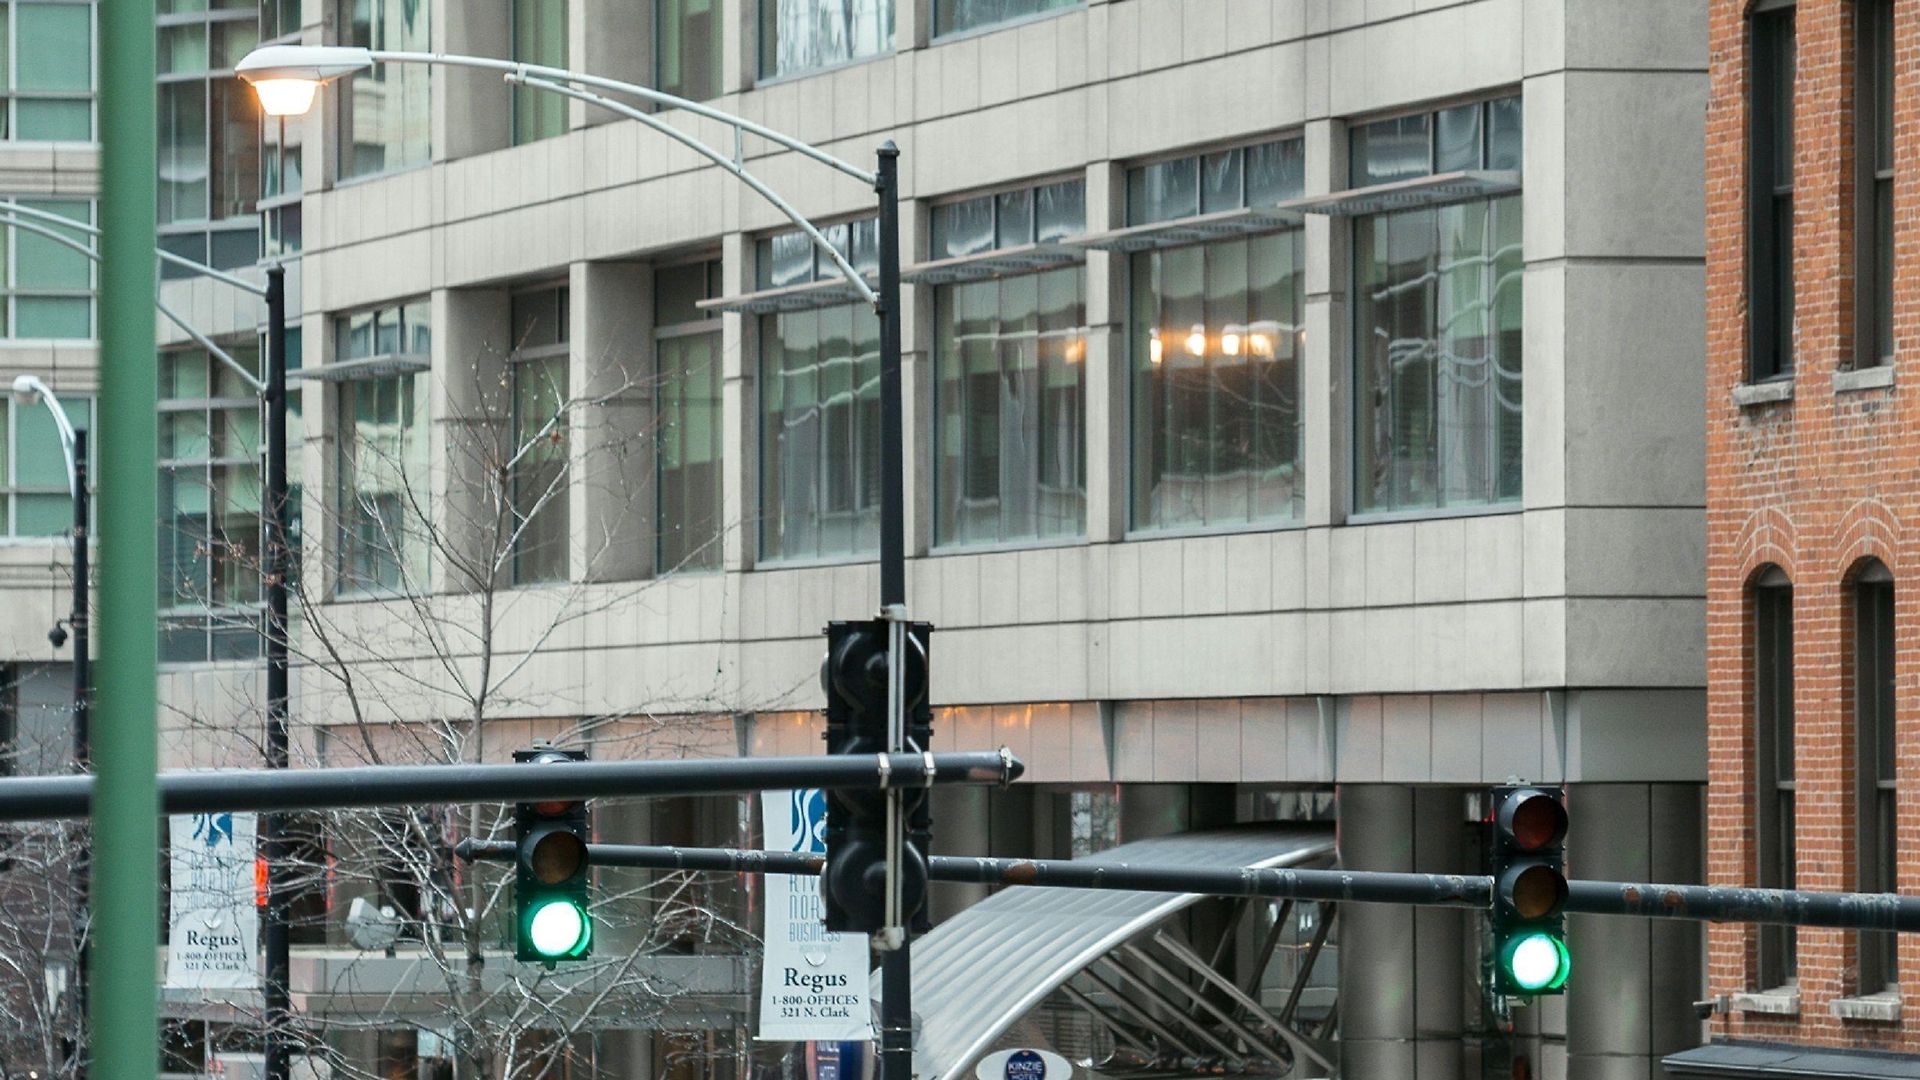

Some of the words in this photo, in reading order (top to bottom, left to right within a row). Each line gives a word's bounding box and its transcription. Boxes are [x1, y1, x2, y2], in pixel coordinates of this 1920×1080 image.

[789, 875, 820, 893] RIV
[789, 895, 821, 920] NOR
[187, 930, 239, 951] Regus
[184, 962, 199, 970] 321
[215, 962, 240, 970] Clark
[784, 967, 847, 993] Regus
[772, 995, 859, 1005] 1-800-OFFICES
[780, 1007, 800, 1018] 321
[804, 1007, 817, 1018] N.
[820, 1006, 850, 1018] Clark
[1008, 1061, 1042, 1071] KINZIE
